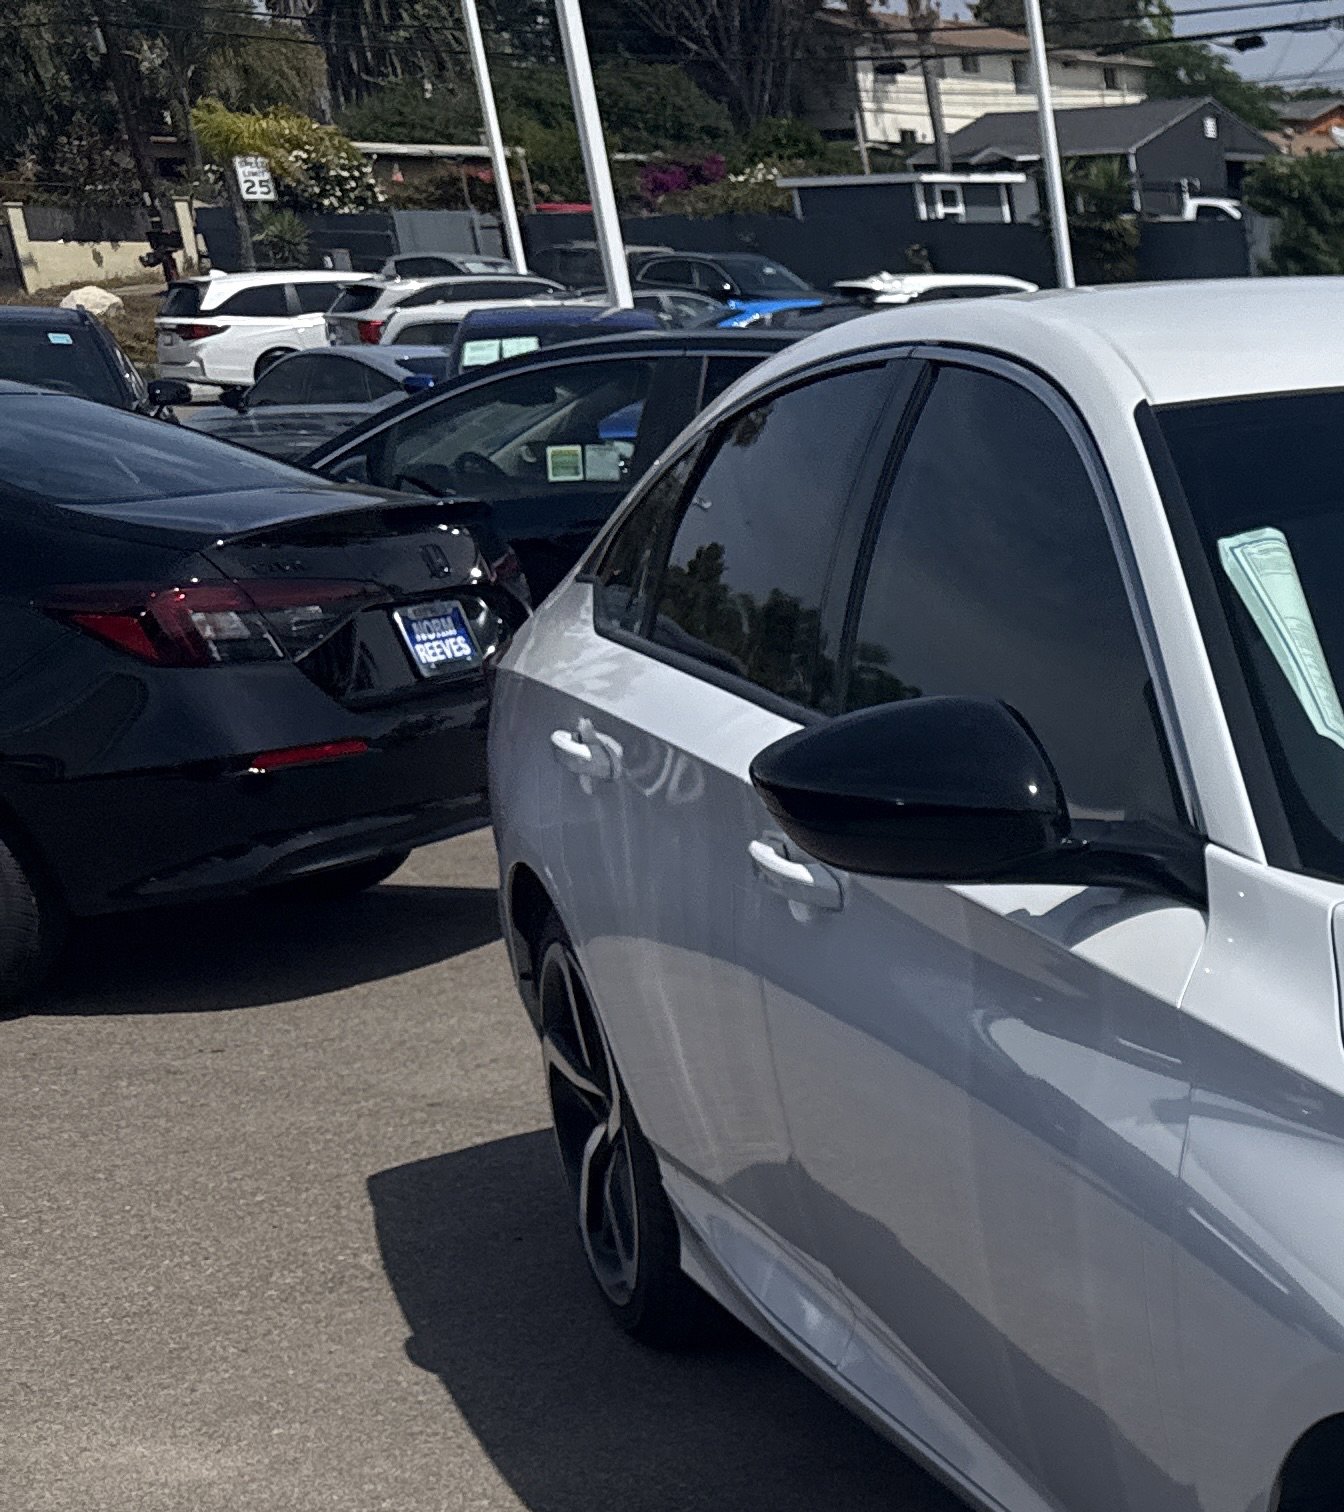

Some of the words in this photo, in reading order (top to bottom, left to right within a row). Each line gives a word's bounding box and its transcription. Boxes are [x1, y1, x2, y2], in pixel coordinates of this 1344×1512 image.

[243, 179, 272, 195] 25
[411, 616, 458, 642] NORM
[415, 635, 472, 664] REEVES
